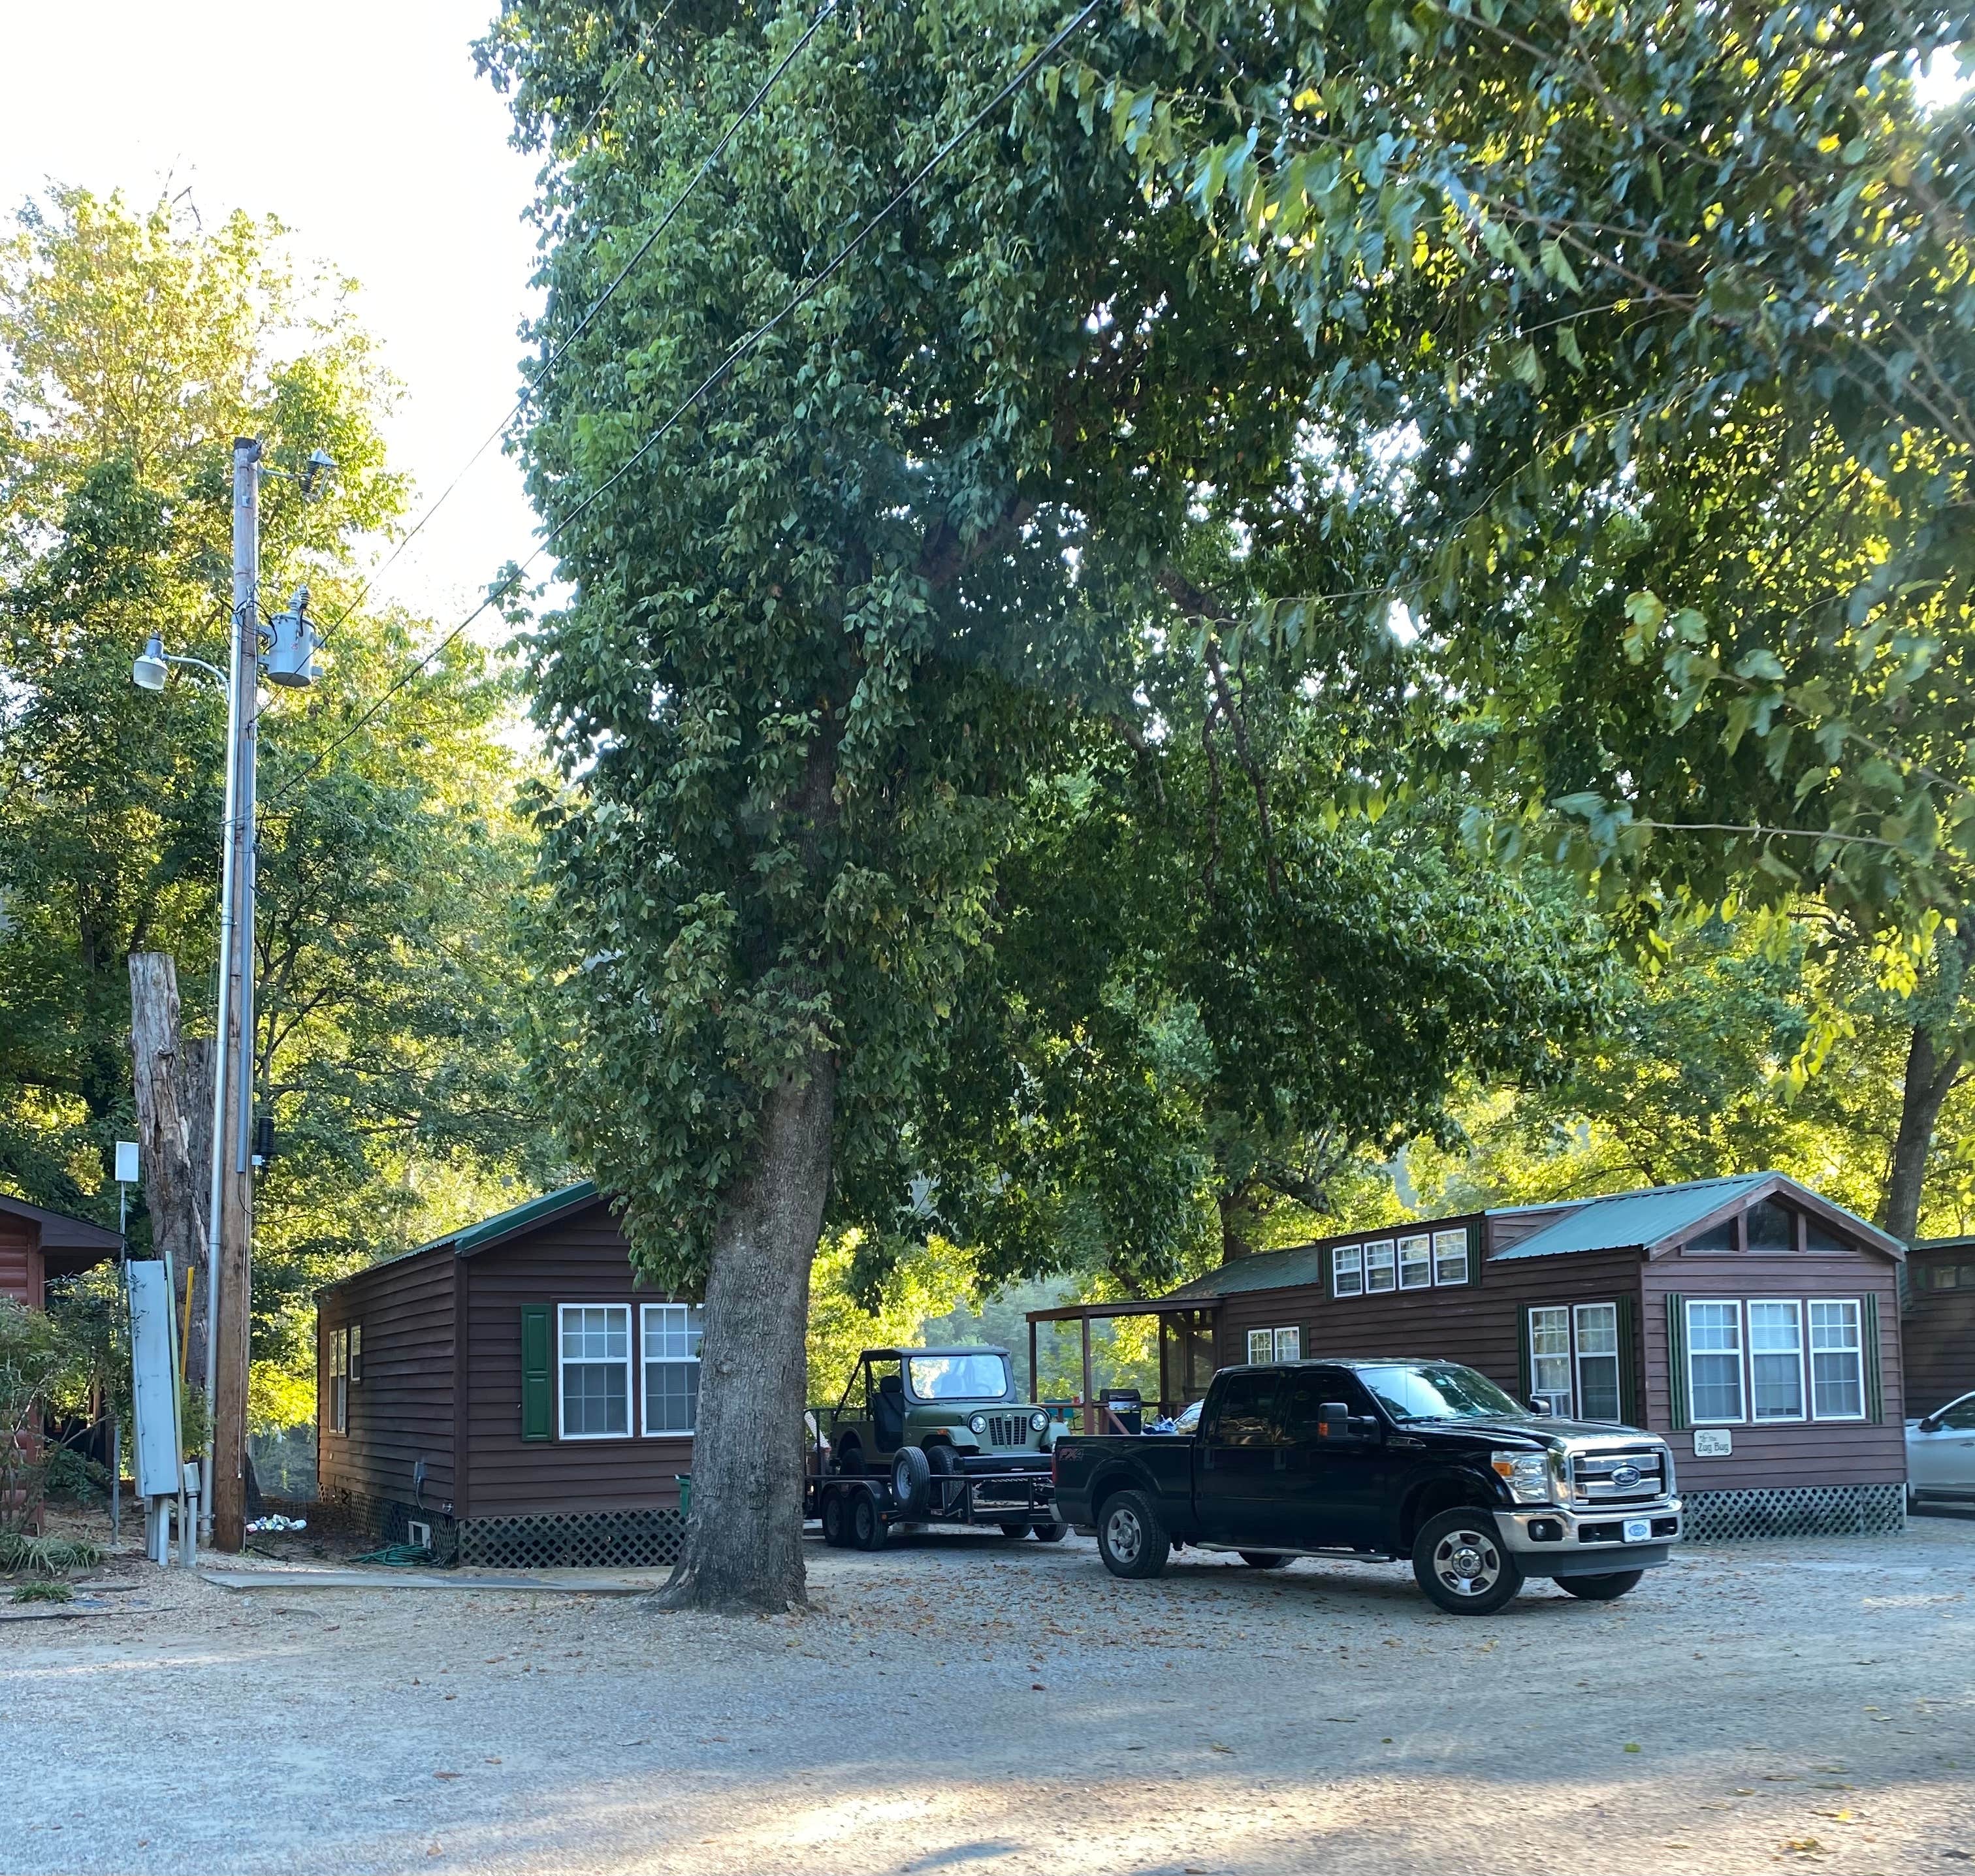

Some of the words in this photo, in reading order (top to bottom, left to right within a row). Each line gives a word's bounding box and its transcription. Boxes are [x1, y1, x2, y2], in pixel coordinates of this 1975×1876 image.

[1060, 1448, 1084, 1459] FX4
[1698, 1442, 1712, 1454] Zug
[1714, 1442, 1729, 1453] Bug
